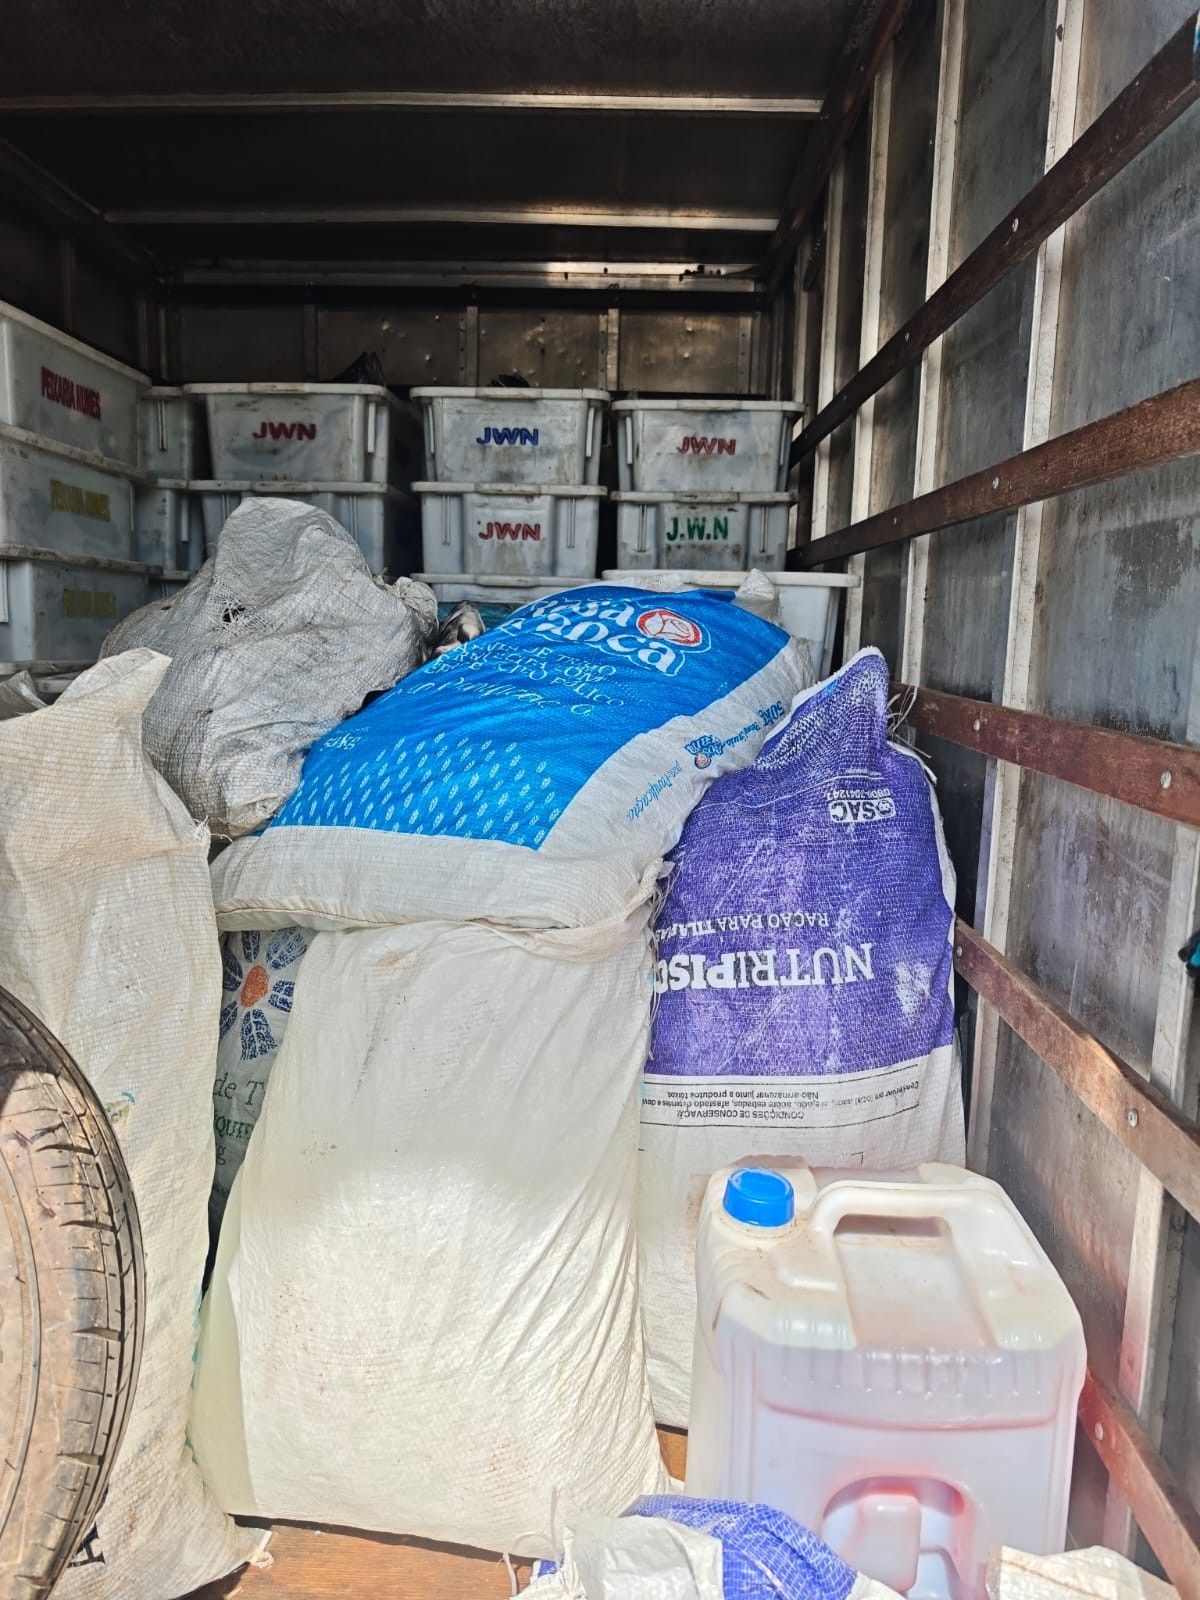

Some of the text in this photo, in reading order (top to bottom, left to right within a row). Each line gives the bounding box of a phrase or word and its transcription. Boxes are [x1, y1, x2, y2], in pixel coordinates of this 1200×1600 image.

[252, 422, 316, 441] JWN
[476, 427, 539, 445] JWN
[676, 436, 736, 455] JWN
[479, 522, 540, 540] JWN
[666, 516, 728, 540] J.W.N
[831, 800, 876, 821] SAC
[717, 912, 763, 931] PARA
[768, 909, 829, 931] RAÇÃO
[690, 1089, 728, 1100] produtos
[693, 1098, 730, 1108] afastado
[735, 1090, 755, 1101] junto
[801, 1090, 819, 1100] Não
[740, 1109, 751, 1119] DE
[753, 1108, 805, 1120] CONDIÇÕES
